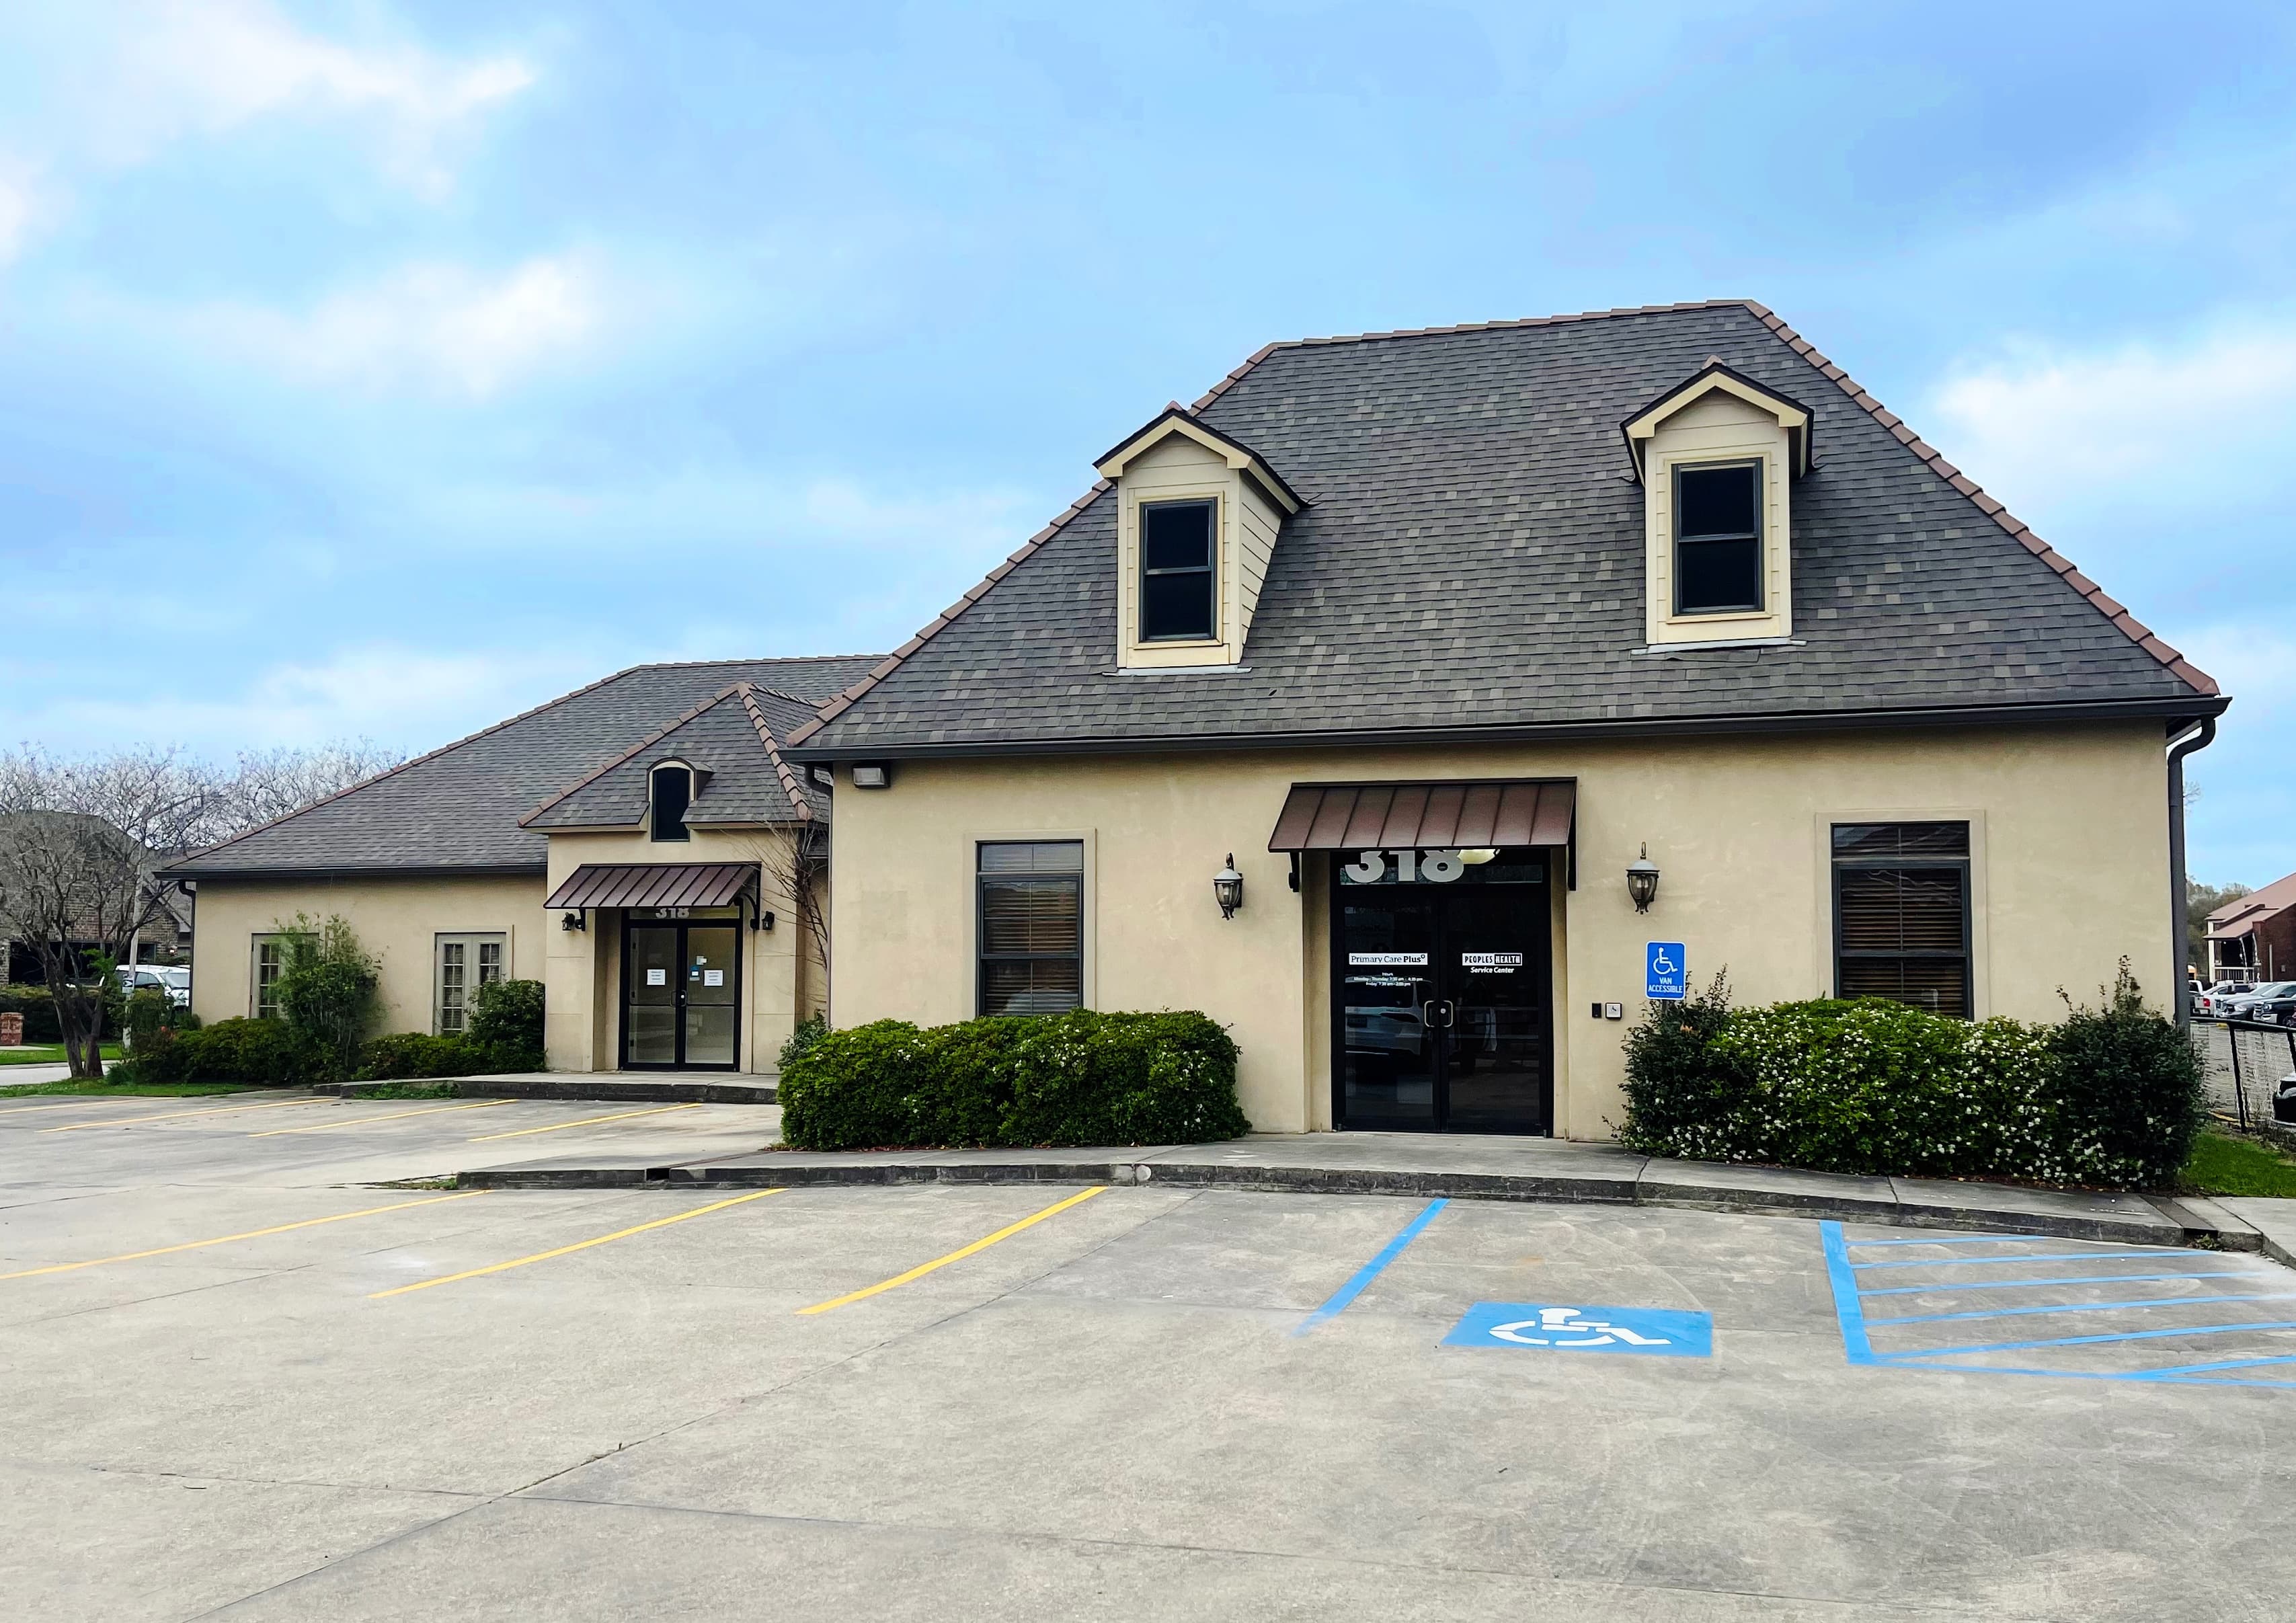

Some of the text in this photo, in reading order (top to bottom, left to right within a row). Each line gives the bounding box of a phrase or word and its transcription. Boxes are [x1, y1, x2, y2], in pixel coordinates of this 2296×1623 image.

[1345, 850, 1464, 883] 318
[656, 908, 689, 918] 318
[1351, 955, 1382, 964] Primary
[1495, 955, 1520, 963] HEALTH
[1659, 977, 1672, 985] VAN
[1648, 984, 1683, 993] ACCESSIBLE
